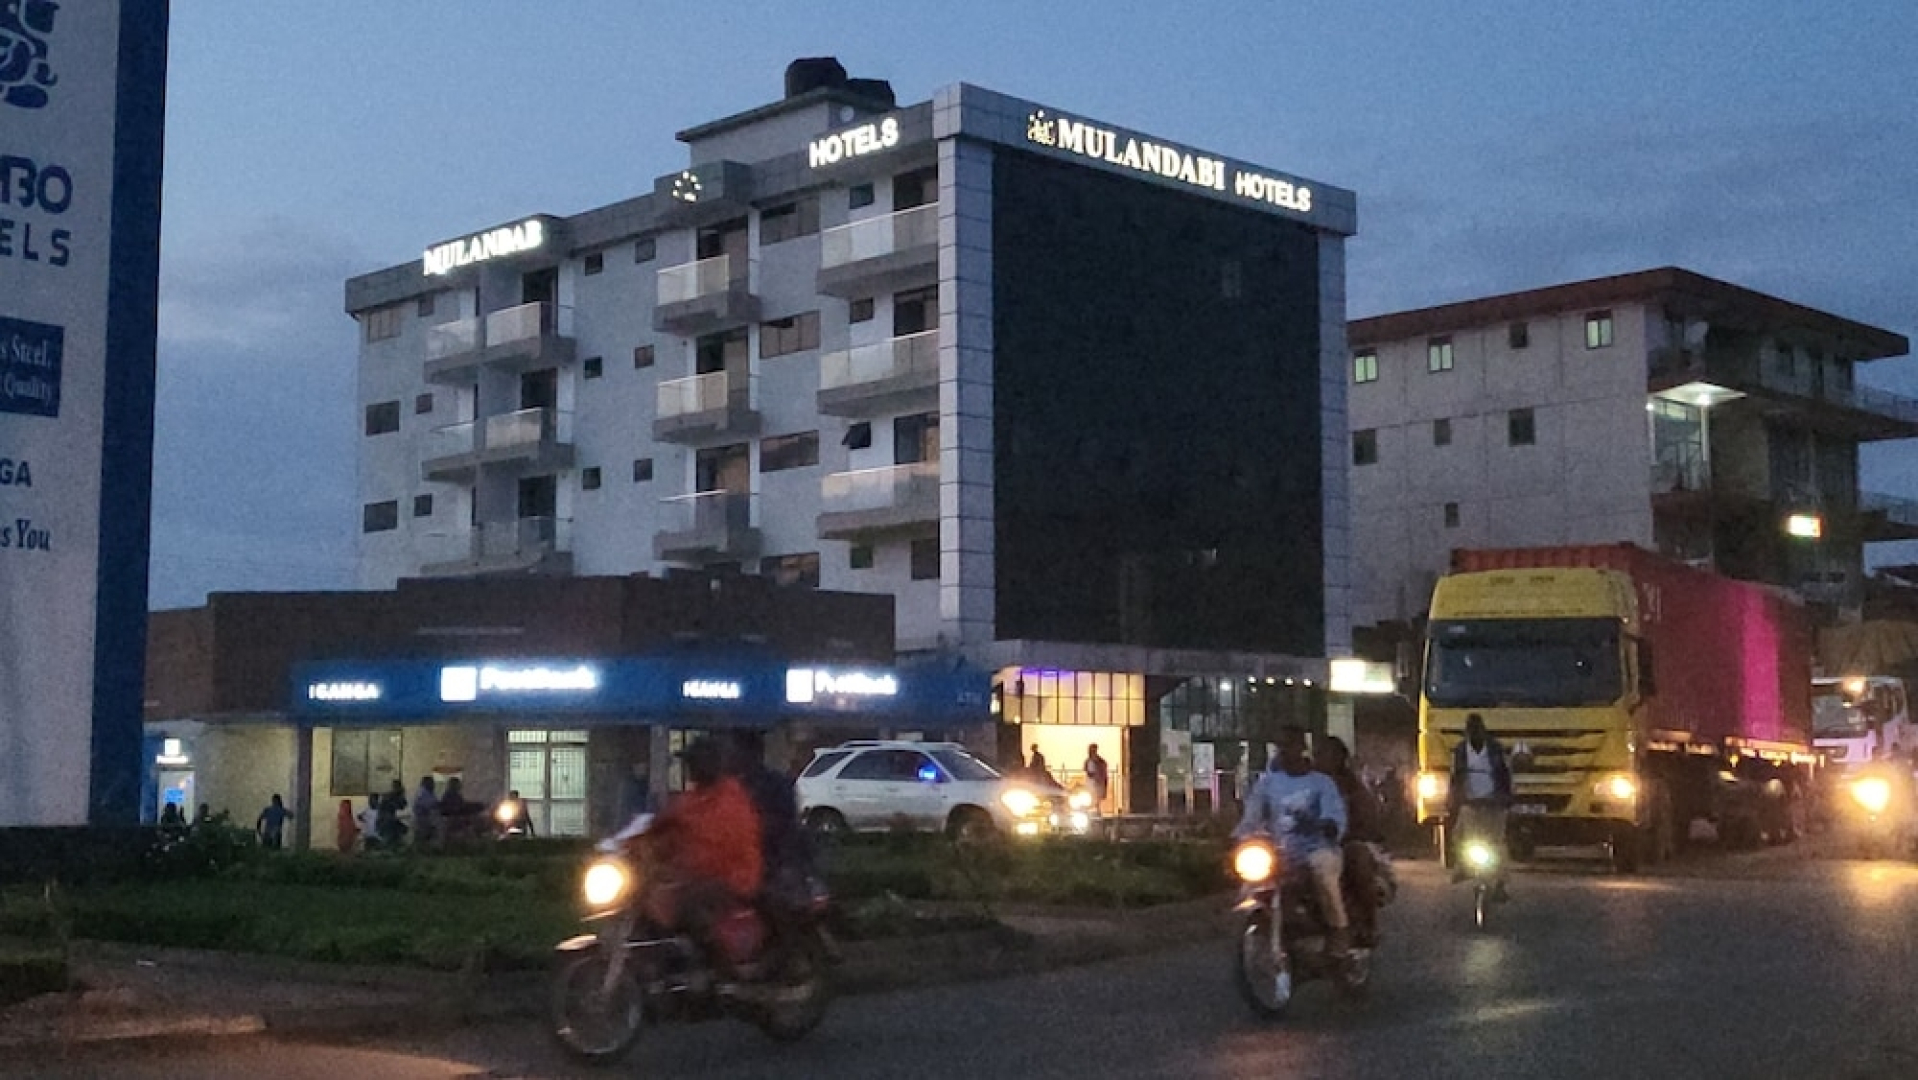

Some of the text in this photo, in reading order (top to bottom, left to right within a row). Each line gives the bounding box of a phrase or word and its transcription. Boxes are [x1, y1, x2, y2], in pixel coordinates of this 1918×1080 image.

[807, 117, 898, 168] HOTELS
[1057, 118, 1311, 211] MULANDABI HOTELS
[15, 517, 51, 551] You
